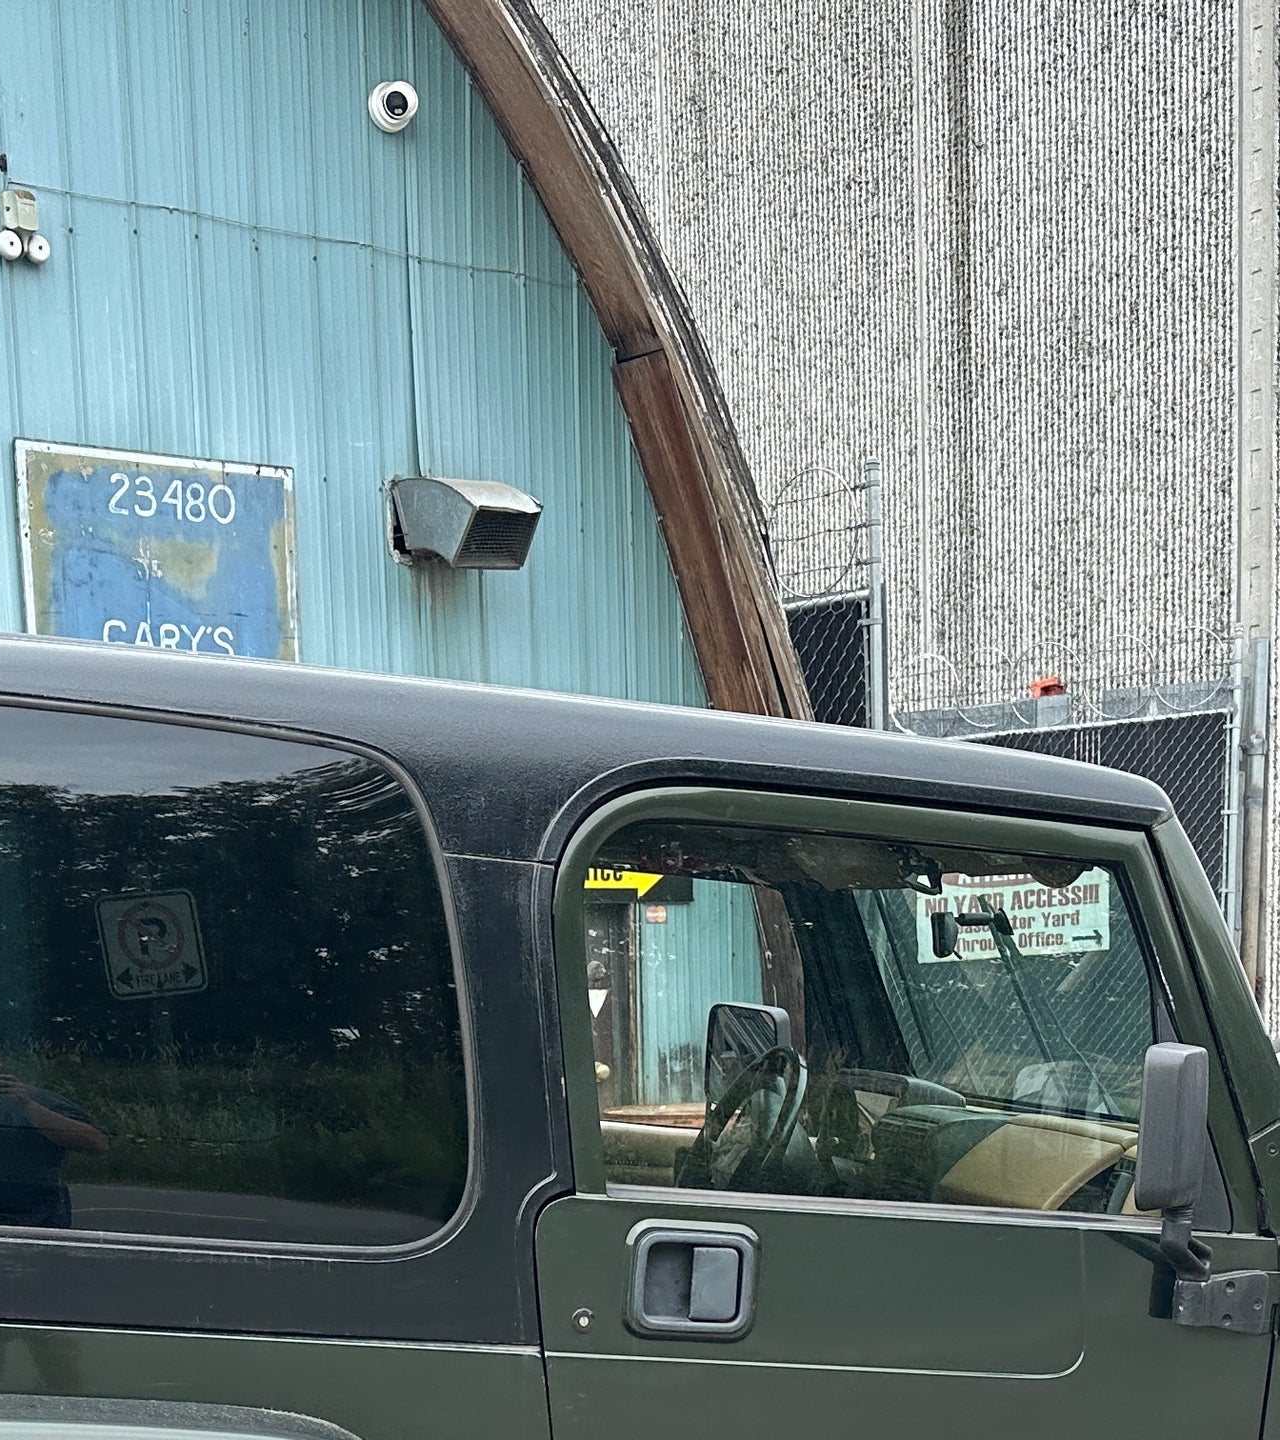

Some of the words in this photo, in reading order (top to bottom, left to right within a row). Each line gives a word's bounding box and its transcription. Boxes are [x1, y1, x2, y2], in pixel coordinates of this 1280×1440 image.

[108, 472, 236, 524] 23480
[1042, 910, 1080, 929] Yard
[1018, 931, 1064, 949] Office
